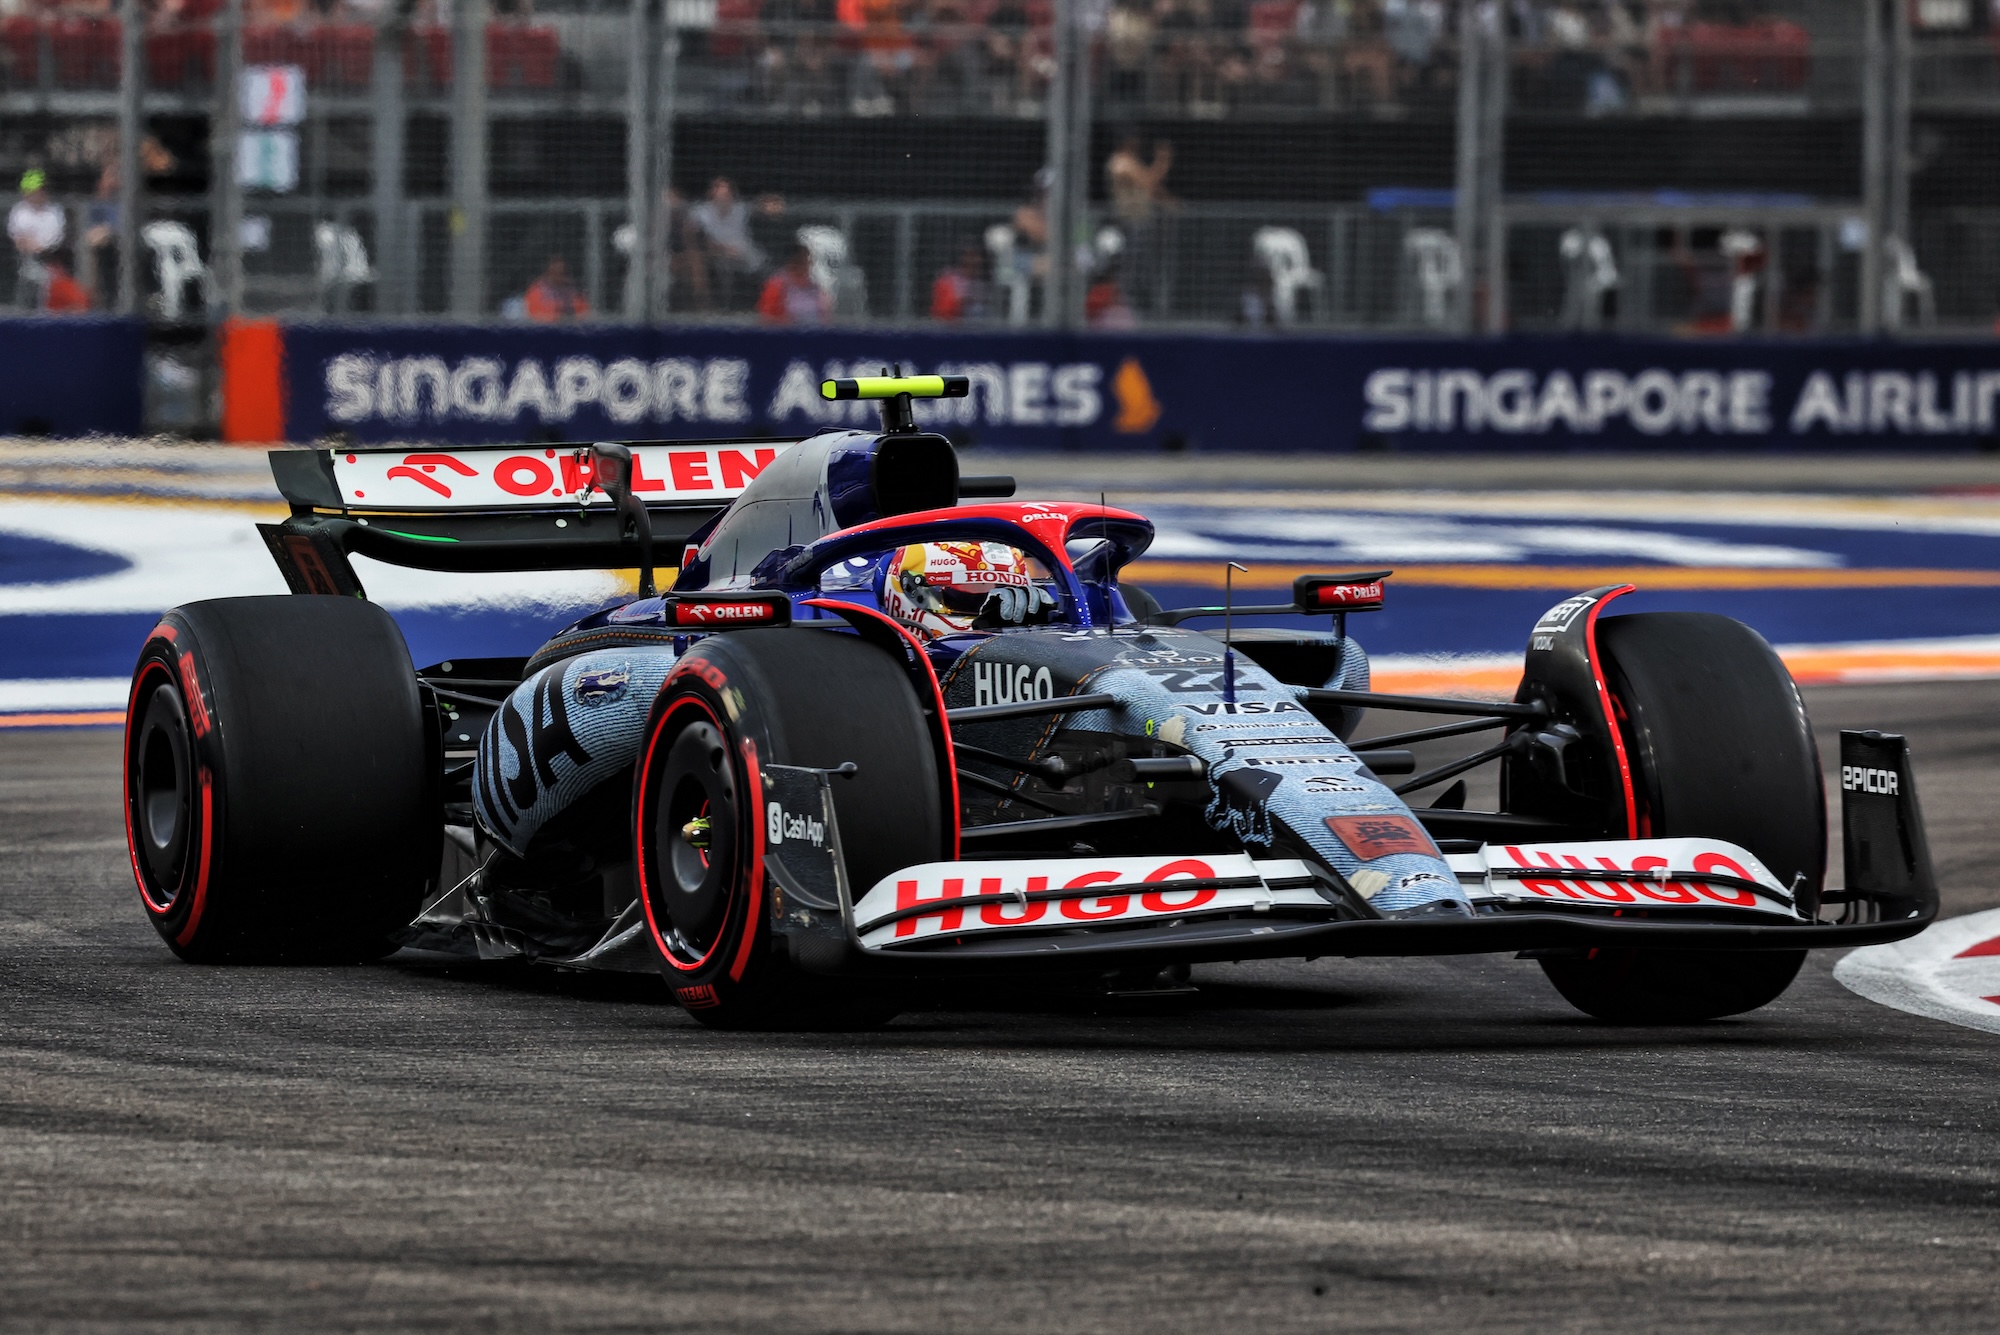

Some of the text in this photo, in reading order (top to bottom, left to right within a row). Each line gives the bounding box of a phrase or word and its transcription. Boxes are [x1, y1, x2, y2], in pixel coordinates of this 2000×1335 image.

[324, 355, 1104, 427] SINGAPORE AIRLINES
[1363, 368, 1773, 435] SINGAPORE
[493, 448, 776, 498] ORLEN
[1022, 512, 1069, 523] ORLEN
[930, 558, 957, 566] HUGO
[965, 571, 1029, 587] HONDA
[1353, 585, 1381, 600] ORLEN
[714, 605, 764, 619] ORLEN
[974, 661, 1054, 708] HUGO
[1146, 668, 1267, 692] 22
[1173, 701, 1307, 715] VISA
[783, 811, 807, 840] Cash
[806, 814, 825, 848] App
[1504, 846, 1757, 907] HUGO
[894, 858, 1218, 938] HUGO
